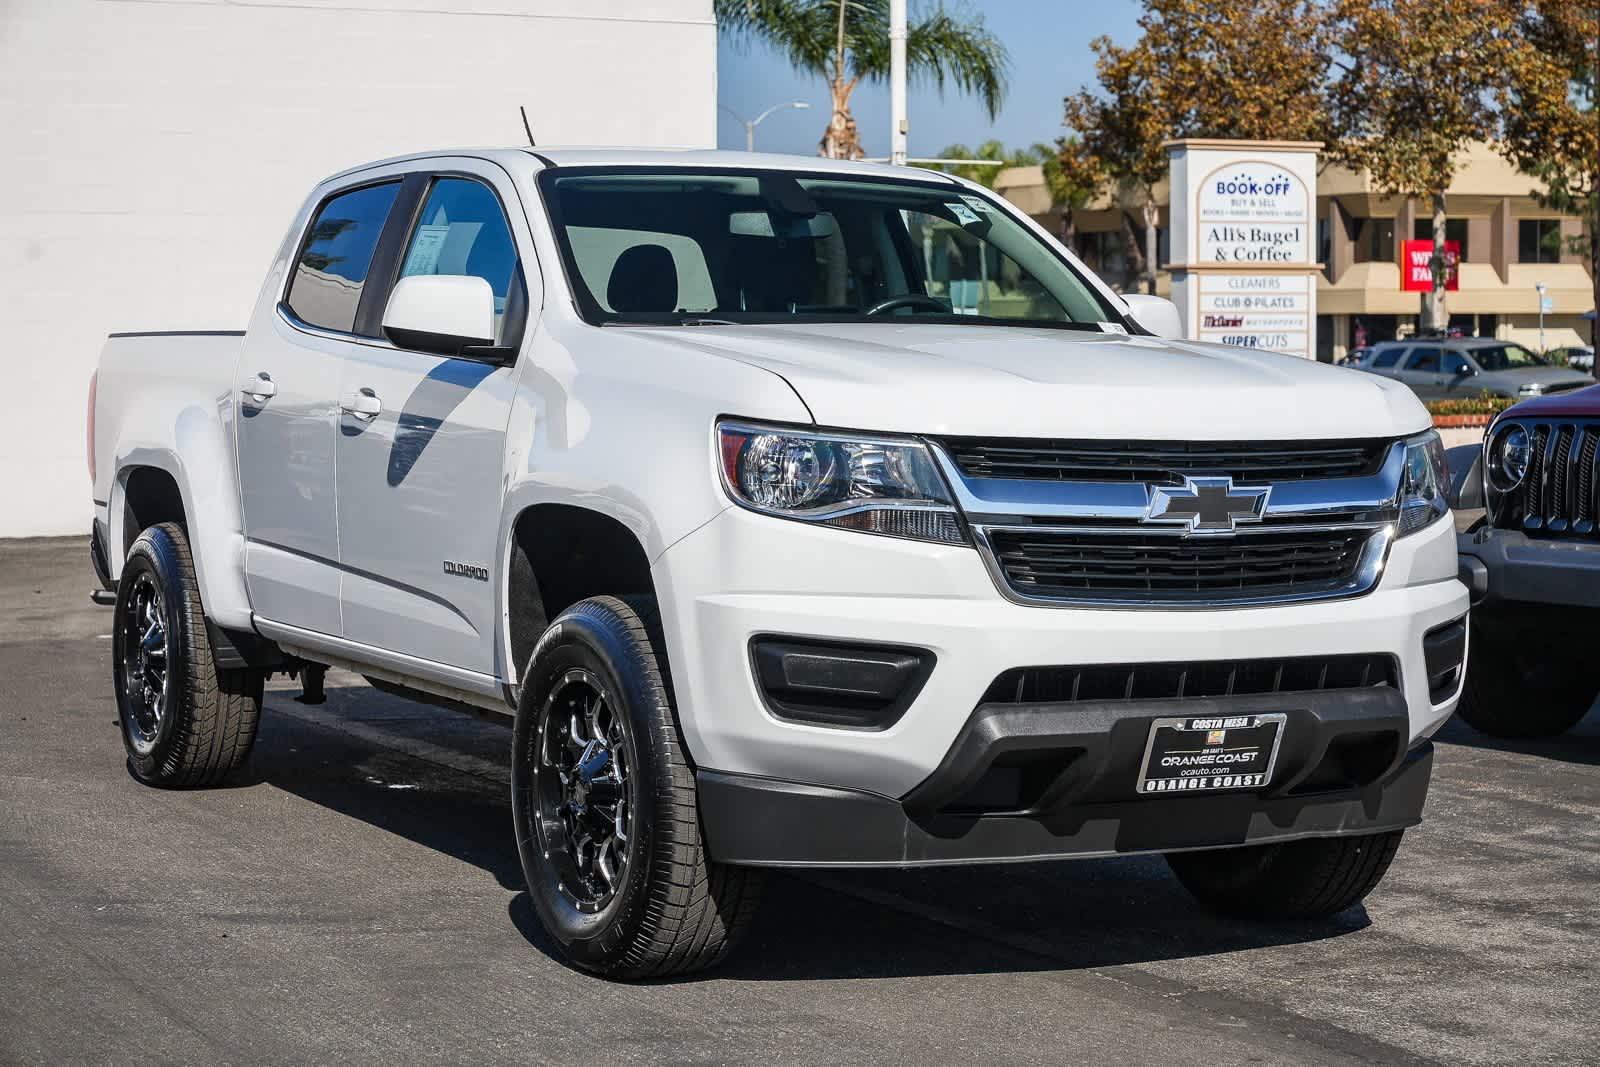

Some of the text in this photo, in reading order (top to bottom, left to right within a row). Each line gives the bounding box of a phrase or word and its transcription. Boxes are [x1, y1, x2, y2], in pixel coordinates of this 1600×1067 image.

[1250, 227, 1299, 246] Bagel
[1215, 246, 1292, 261] & Coffee
[1228, 278, 1280, 289] CLEANERS
[1214, 297, 1295, 308] CLUB PILATES
[443, 560, 489, 582] COLORADO
[1192, 717, 1249, 729] COSTA MESA
[1161, 752, 1258, 766] ORANGE COAST
[1180, 767, 1230, 776] ocauto.com
[1146, 775, 1263, 791] ORANGE COAST
